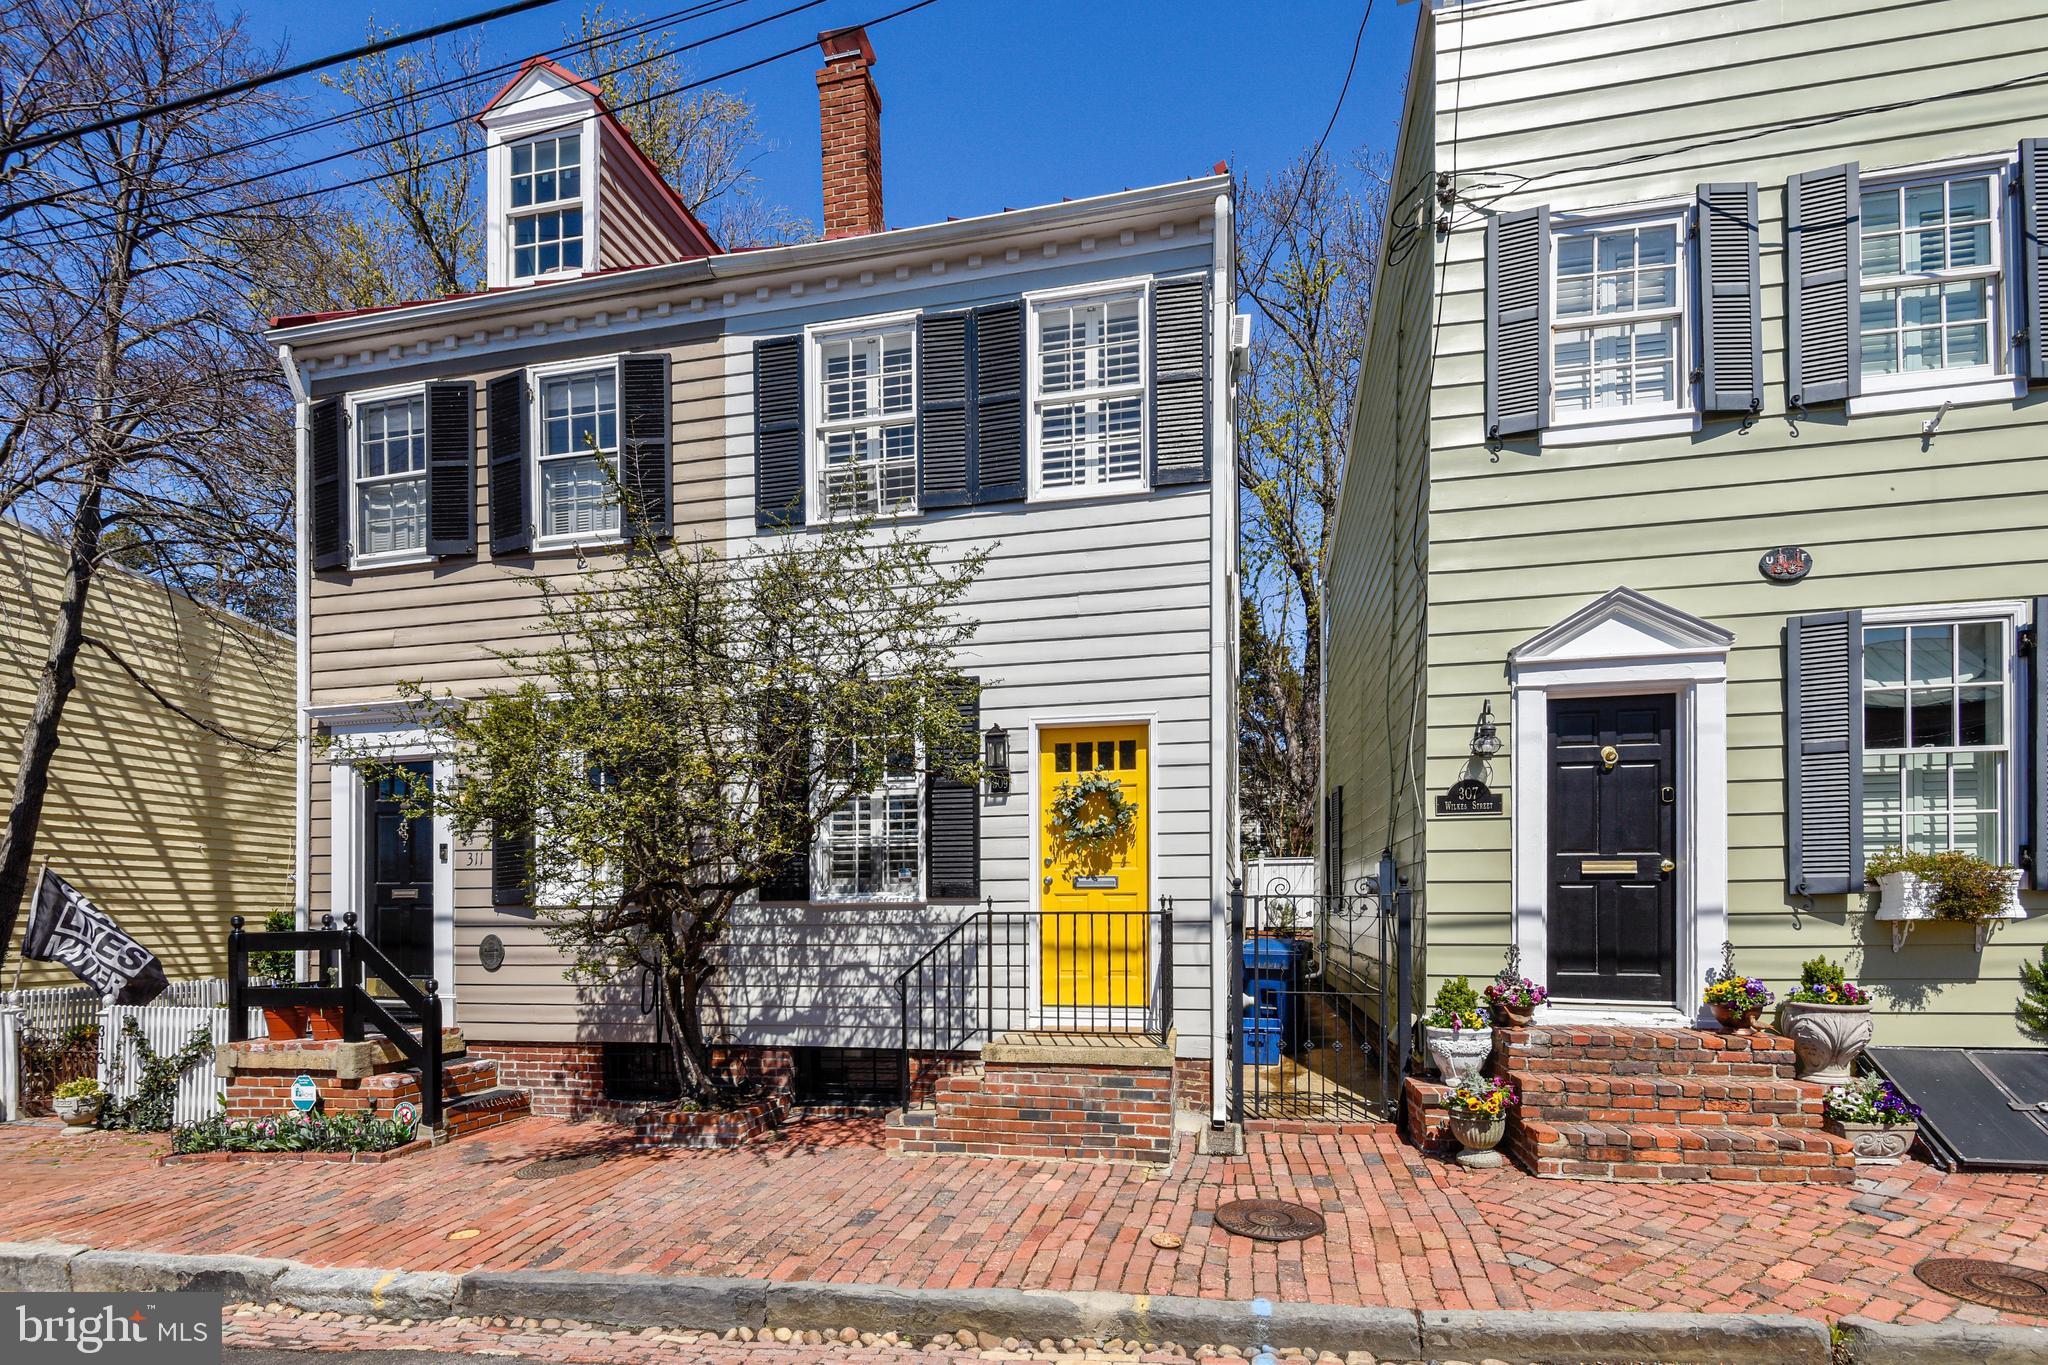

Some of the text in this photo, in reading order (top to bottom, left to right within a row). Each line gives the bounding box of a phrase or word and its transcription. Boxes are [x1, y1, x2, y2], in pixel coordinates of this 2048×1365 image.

[1458, 786, 1479, 800] 307
[467, 852, 484, 867] 311
[60, 905, 148, 971] LIVES
[43, 934, 128, 1000] MATTER
[97, 1025, 107, 1065] 313
